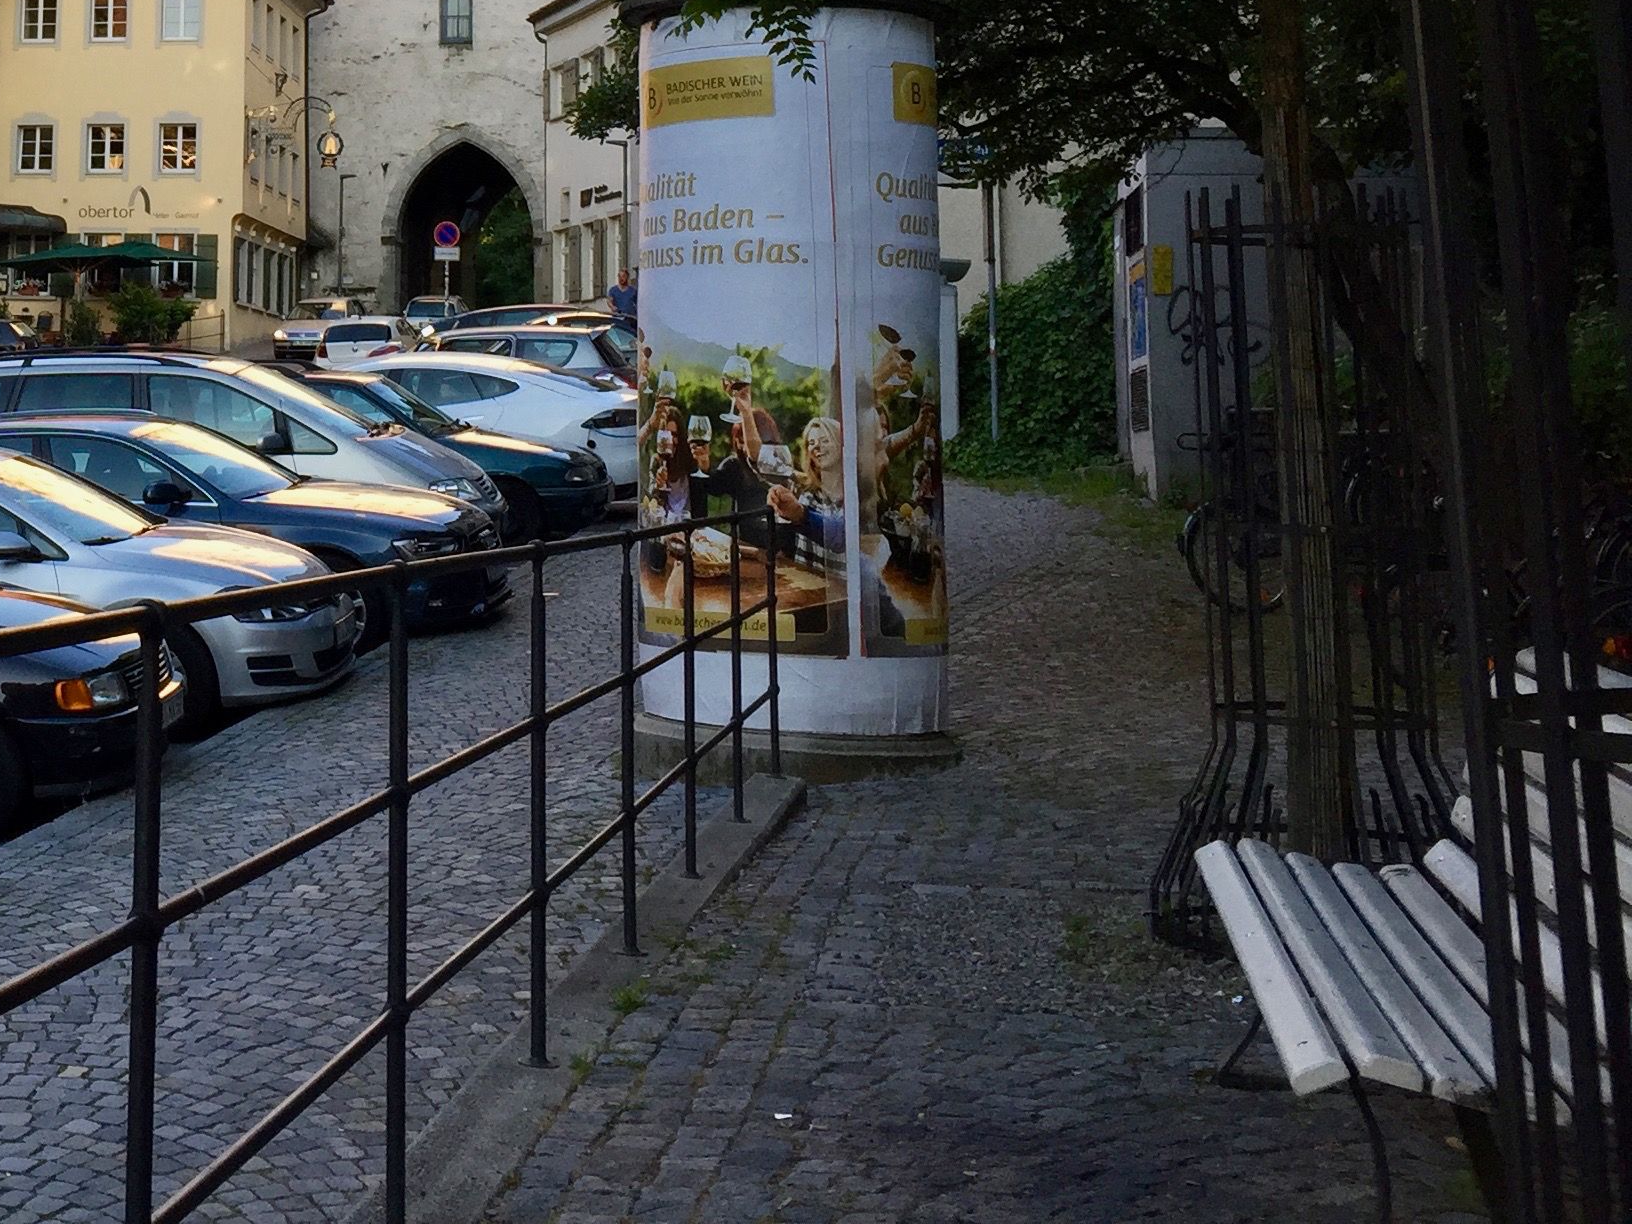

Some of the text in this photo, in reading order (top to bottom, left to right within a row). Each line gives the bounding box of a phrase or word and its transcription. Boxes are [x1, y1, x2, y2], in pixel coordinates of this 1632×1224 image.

[79, 205, 135, 219] obertor
[673, 203, 754, 233] Baden
[899, 214, 929, 235] aus
[692, 239, 724, 265] im
[734, 237, 809, 265] Glas.
